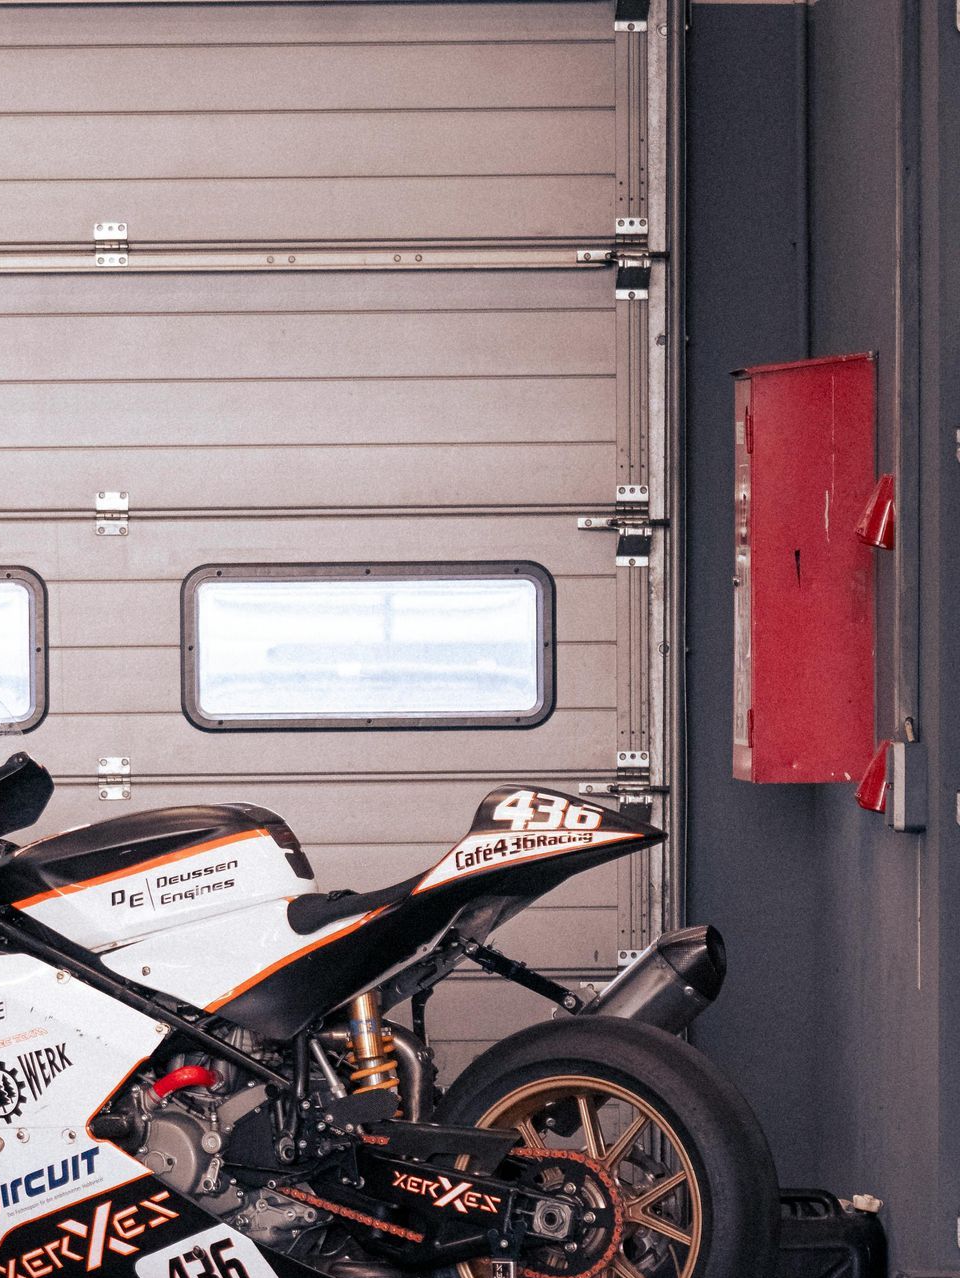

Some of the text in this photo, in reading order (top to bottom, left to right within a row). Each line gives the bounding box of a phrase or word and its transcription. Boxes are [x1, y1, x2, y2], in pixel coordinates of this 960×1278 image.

[493, 790, 604, 831] 436
[156, 859, 238, 889] Deussen
[160, 878, 235, 905] Engines
[17, 1042, 74, 1102] WERK
